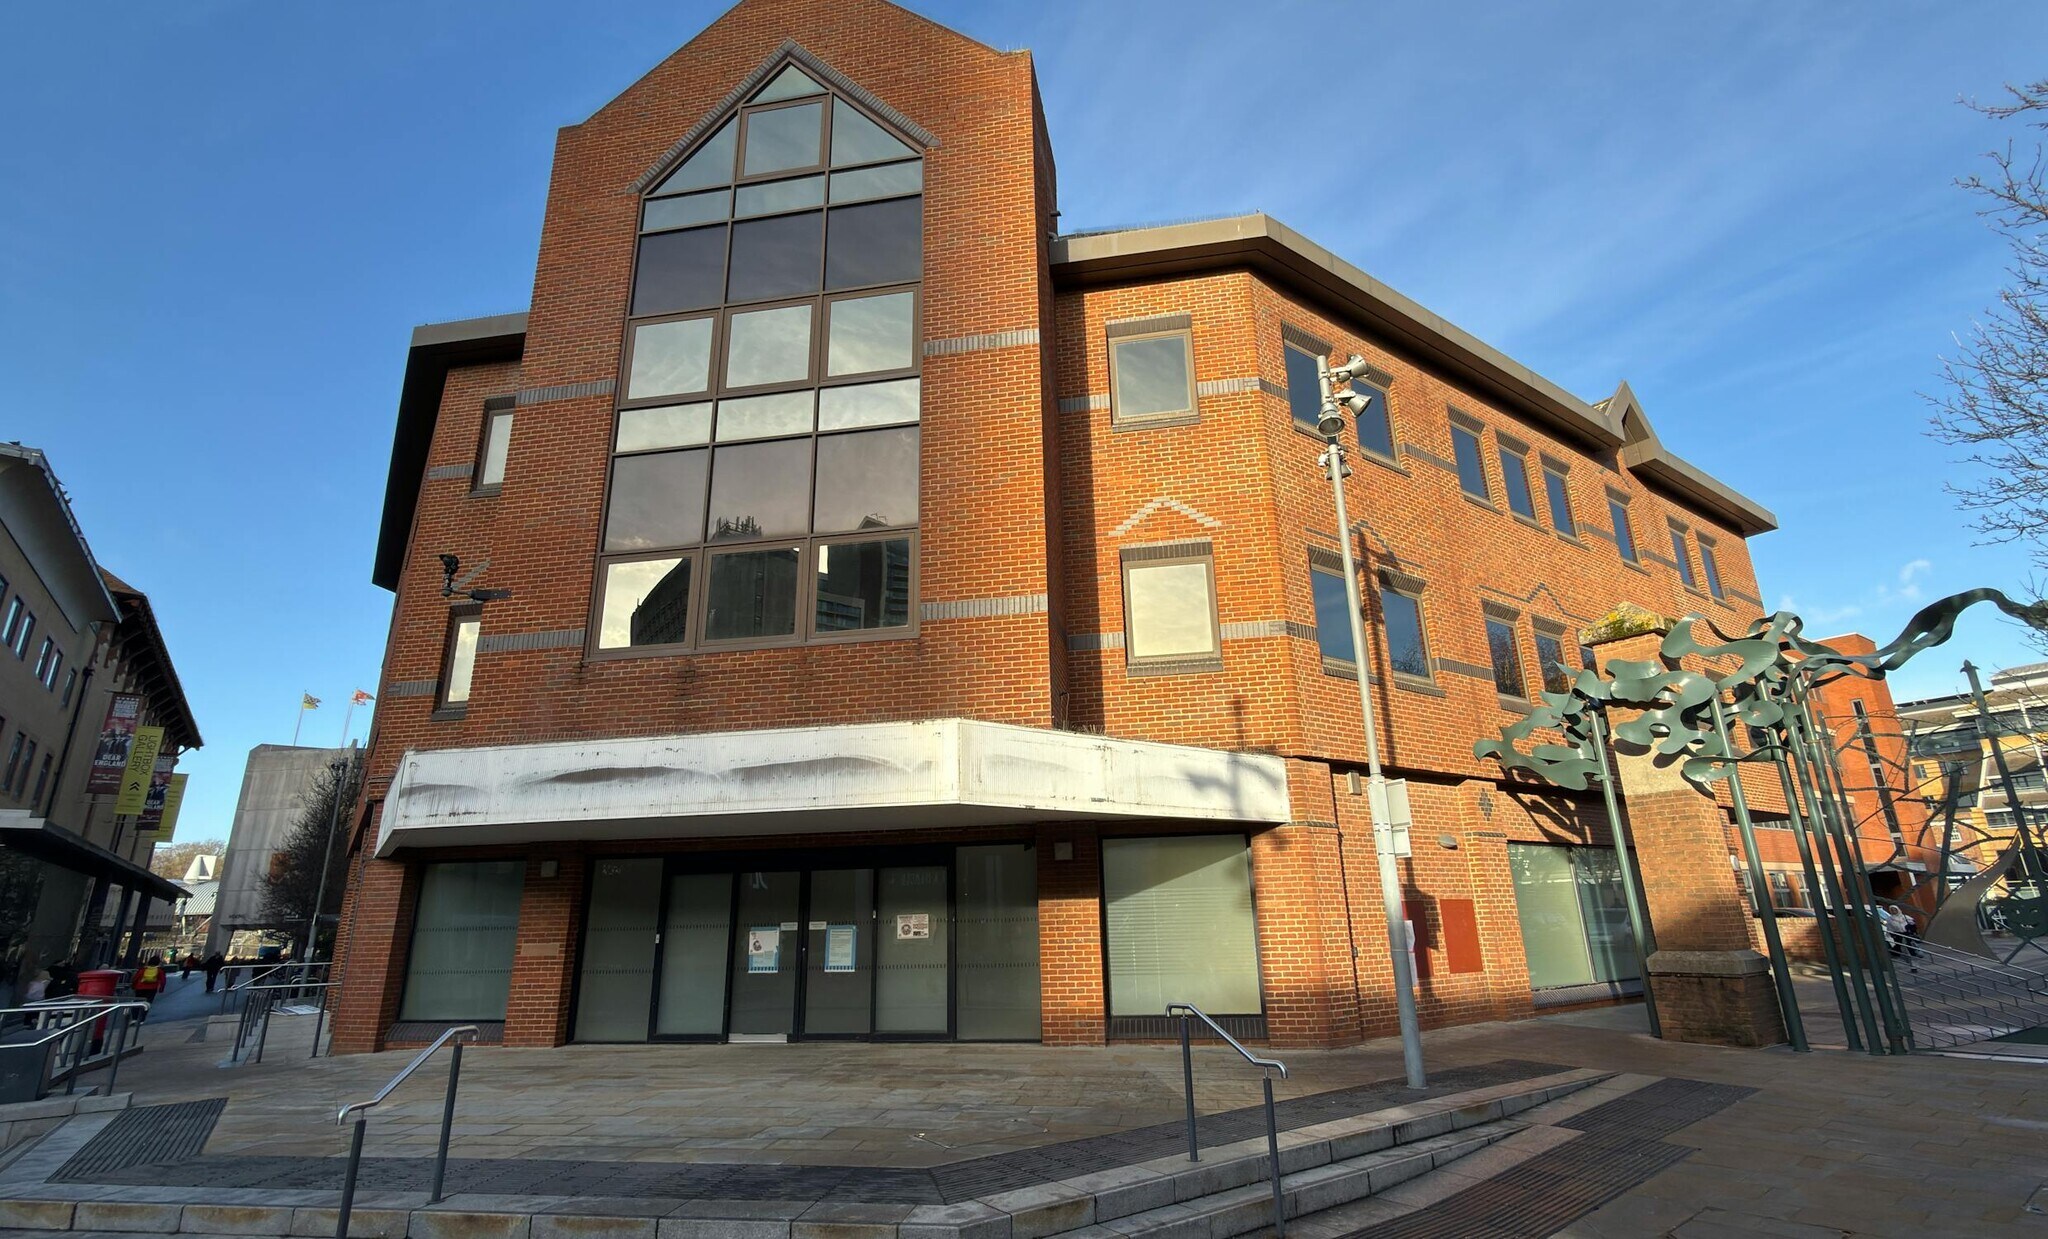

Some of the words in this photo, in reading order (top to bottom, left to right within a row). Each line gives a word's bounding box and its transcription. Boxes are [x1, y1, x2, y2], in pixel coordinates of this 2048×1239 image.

[94, 759, 126, 767] ENGLAND
[131, 735, 147, 772] GALLERY
[139, 735, 158, 776] LIGHTBOX
